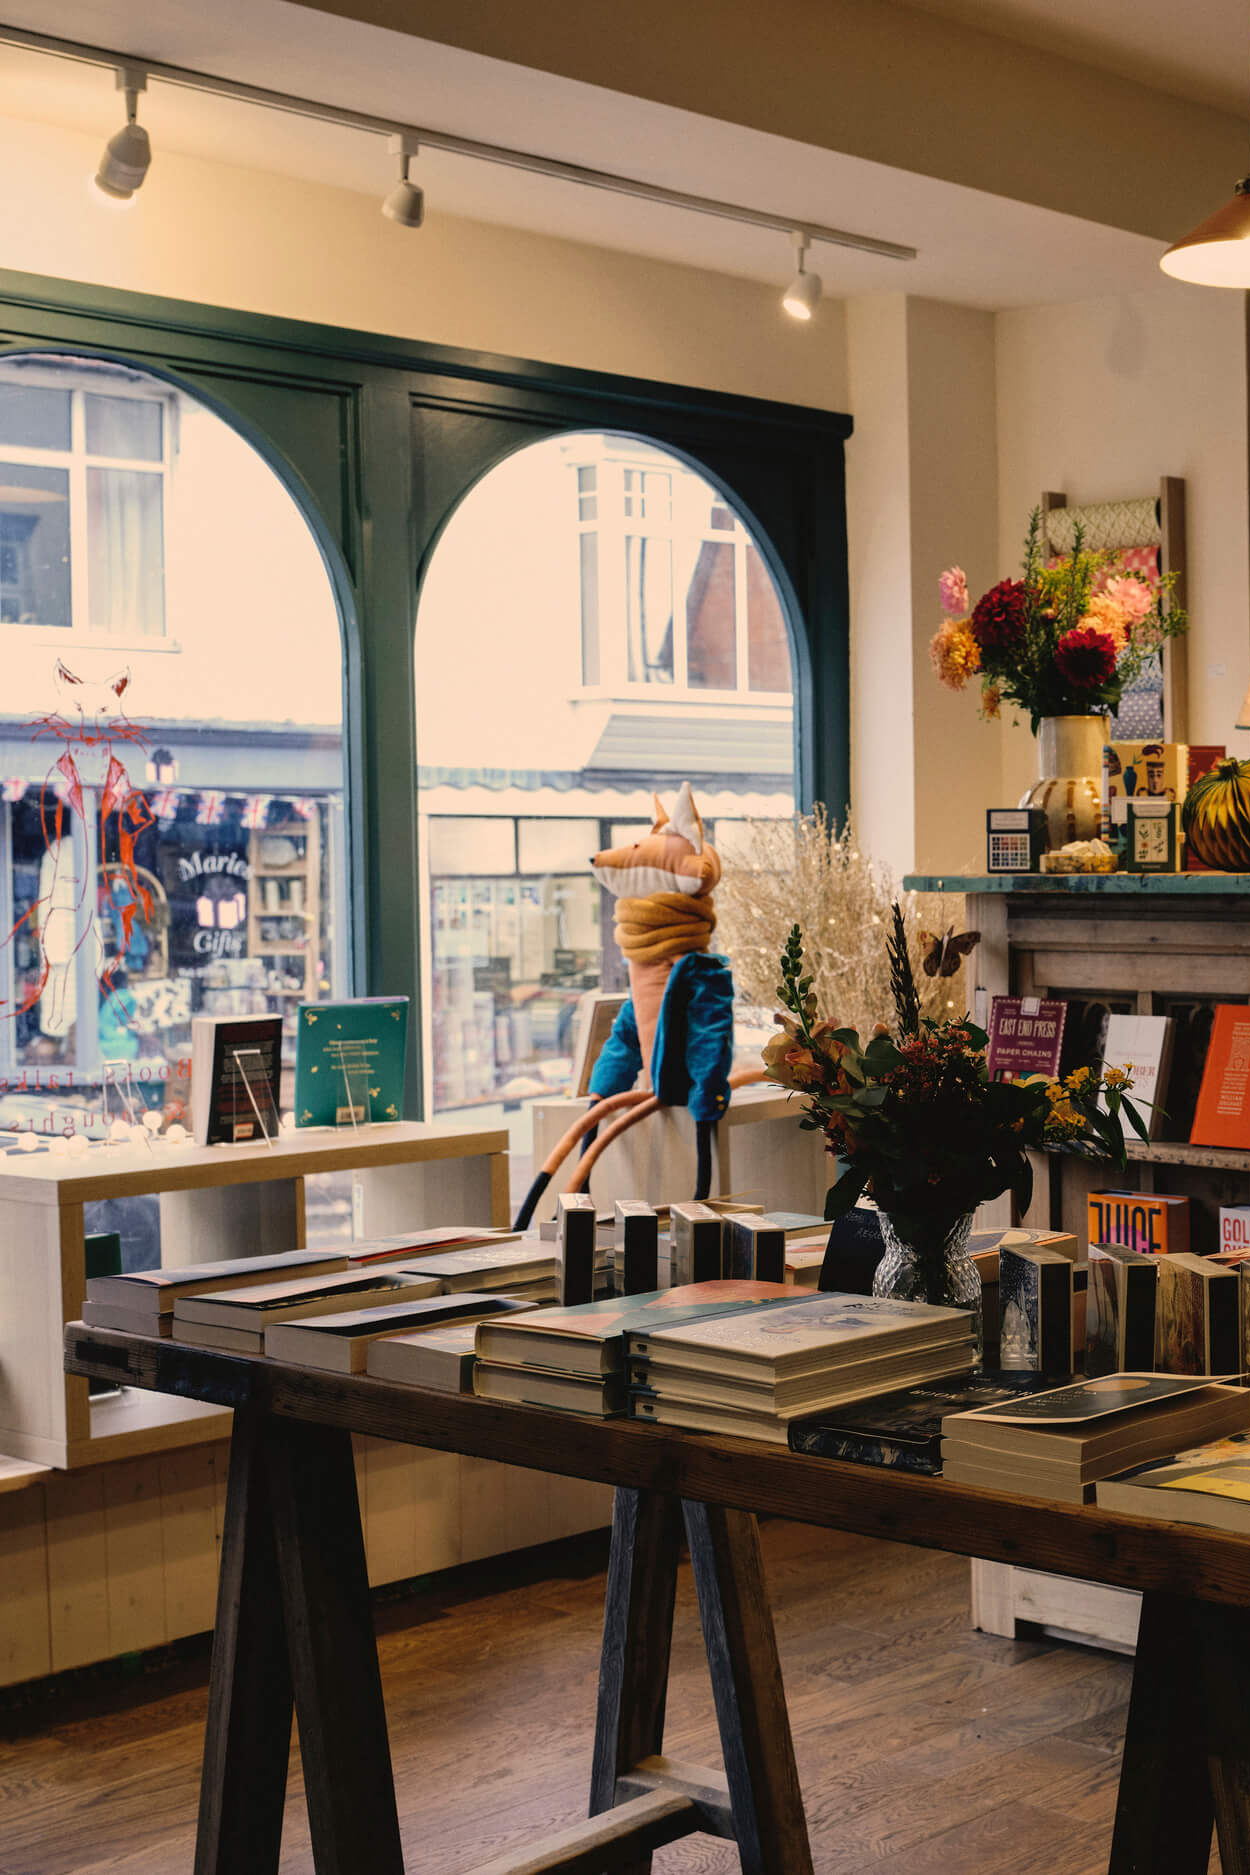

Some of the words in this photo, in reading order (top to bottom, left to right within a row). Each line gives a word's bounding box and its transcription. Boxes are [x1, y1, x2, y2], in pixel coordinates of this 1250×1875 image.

[193, 930, 242, 958] Gifts
[999, 1018, 1017, 1036] EAST
[1017, 1019, 1033, 1037] END
[1033, 1020, 1057, 1038] PRESS
[996, 1047, 1021, 1056] PAPER
[1022, 1049, 1052, 1058] CHAINS
